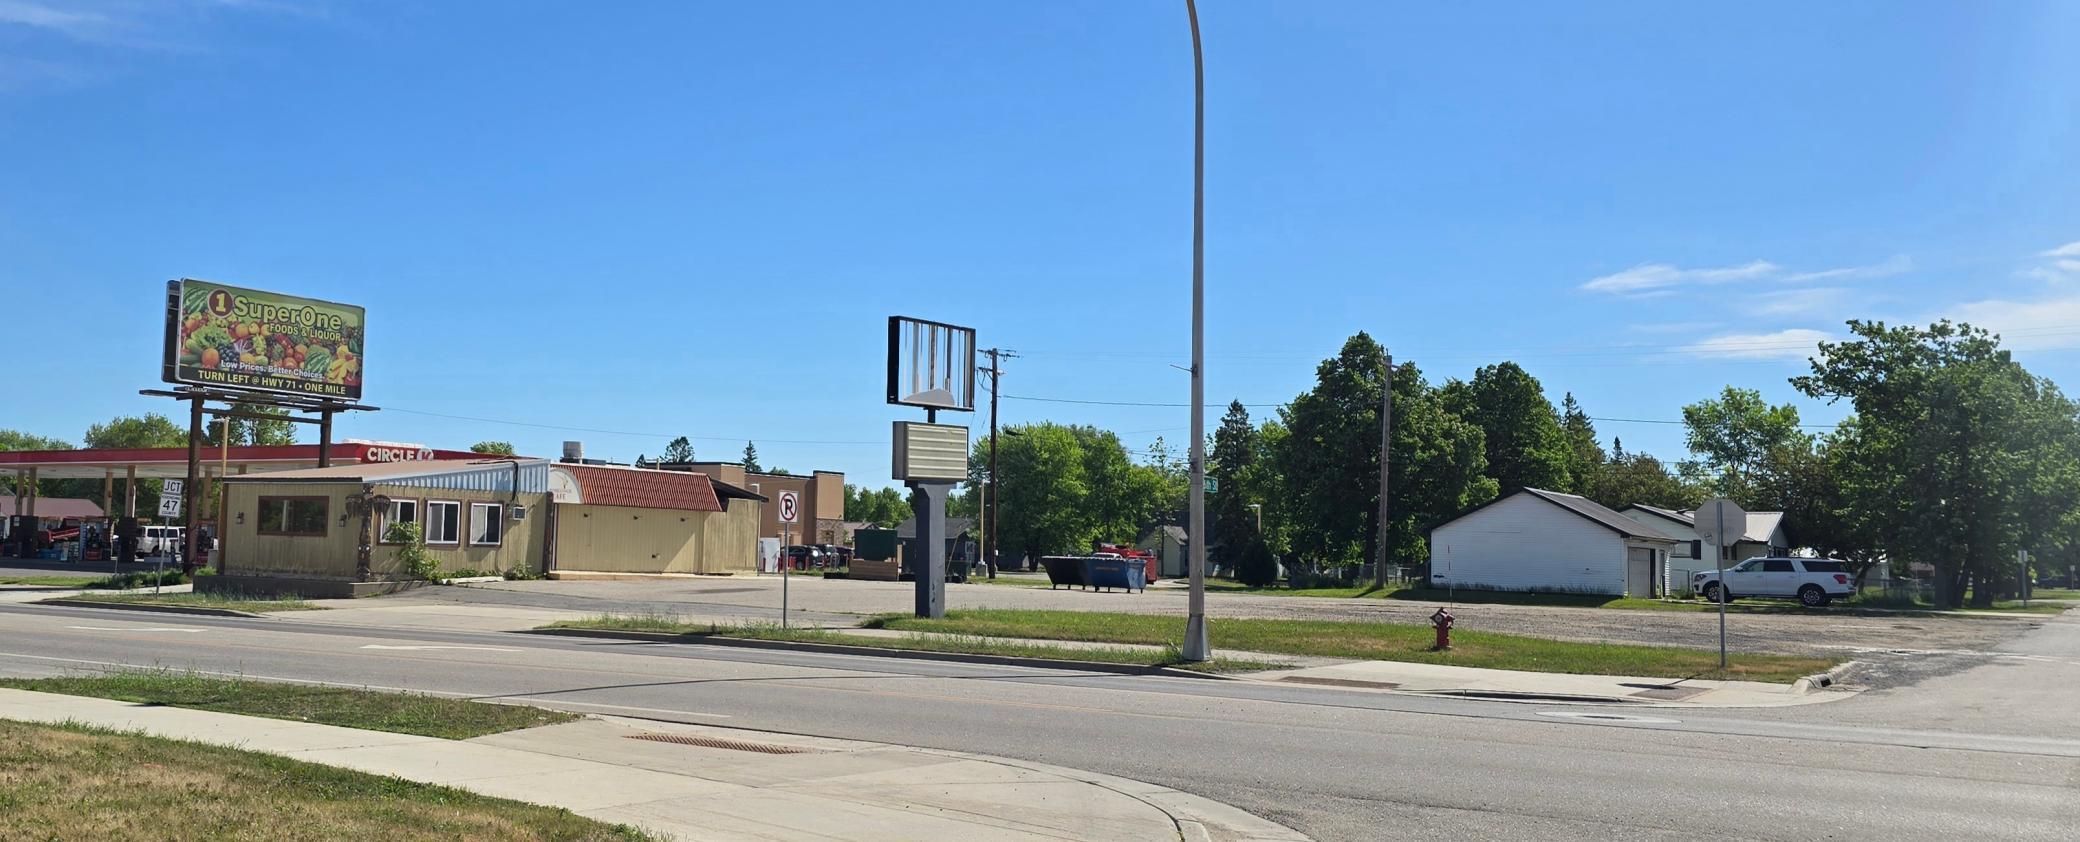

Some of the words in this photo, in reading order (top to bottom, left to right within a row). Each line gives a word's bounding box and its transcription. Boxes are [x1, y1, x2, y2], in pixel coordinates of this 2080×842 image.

[233, 295, 343, 330] SuperOne
[269, 323, 298, 336] FOODS
[301, 327, 308, 337] &
[309, 328, 342, 341] LIQUOR
[221, 360, 238, 370] Low
[267, 365, 293, 376] Better
[293, 369, 325, 380] Choices.
[198, 370, 225, 382] TURN
[227, 373, 250, 384] LEFT
[252, 376, 260, 385] @
[261, 377, 284, 388] HWY
[285, 379, 297, 389] 71
[304, 382, 323, 393] ONE
[325, 384, 346, 395] MILE
[367, 447, 416, 464] CIRCLE
[165, 481, 181, 492] JCT
[163, 500, 178, 511] 47
